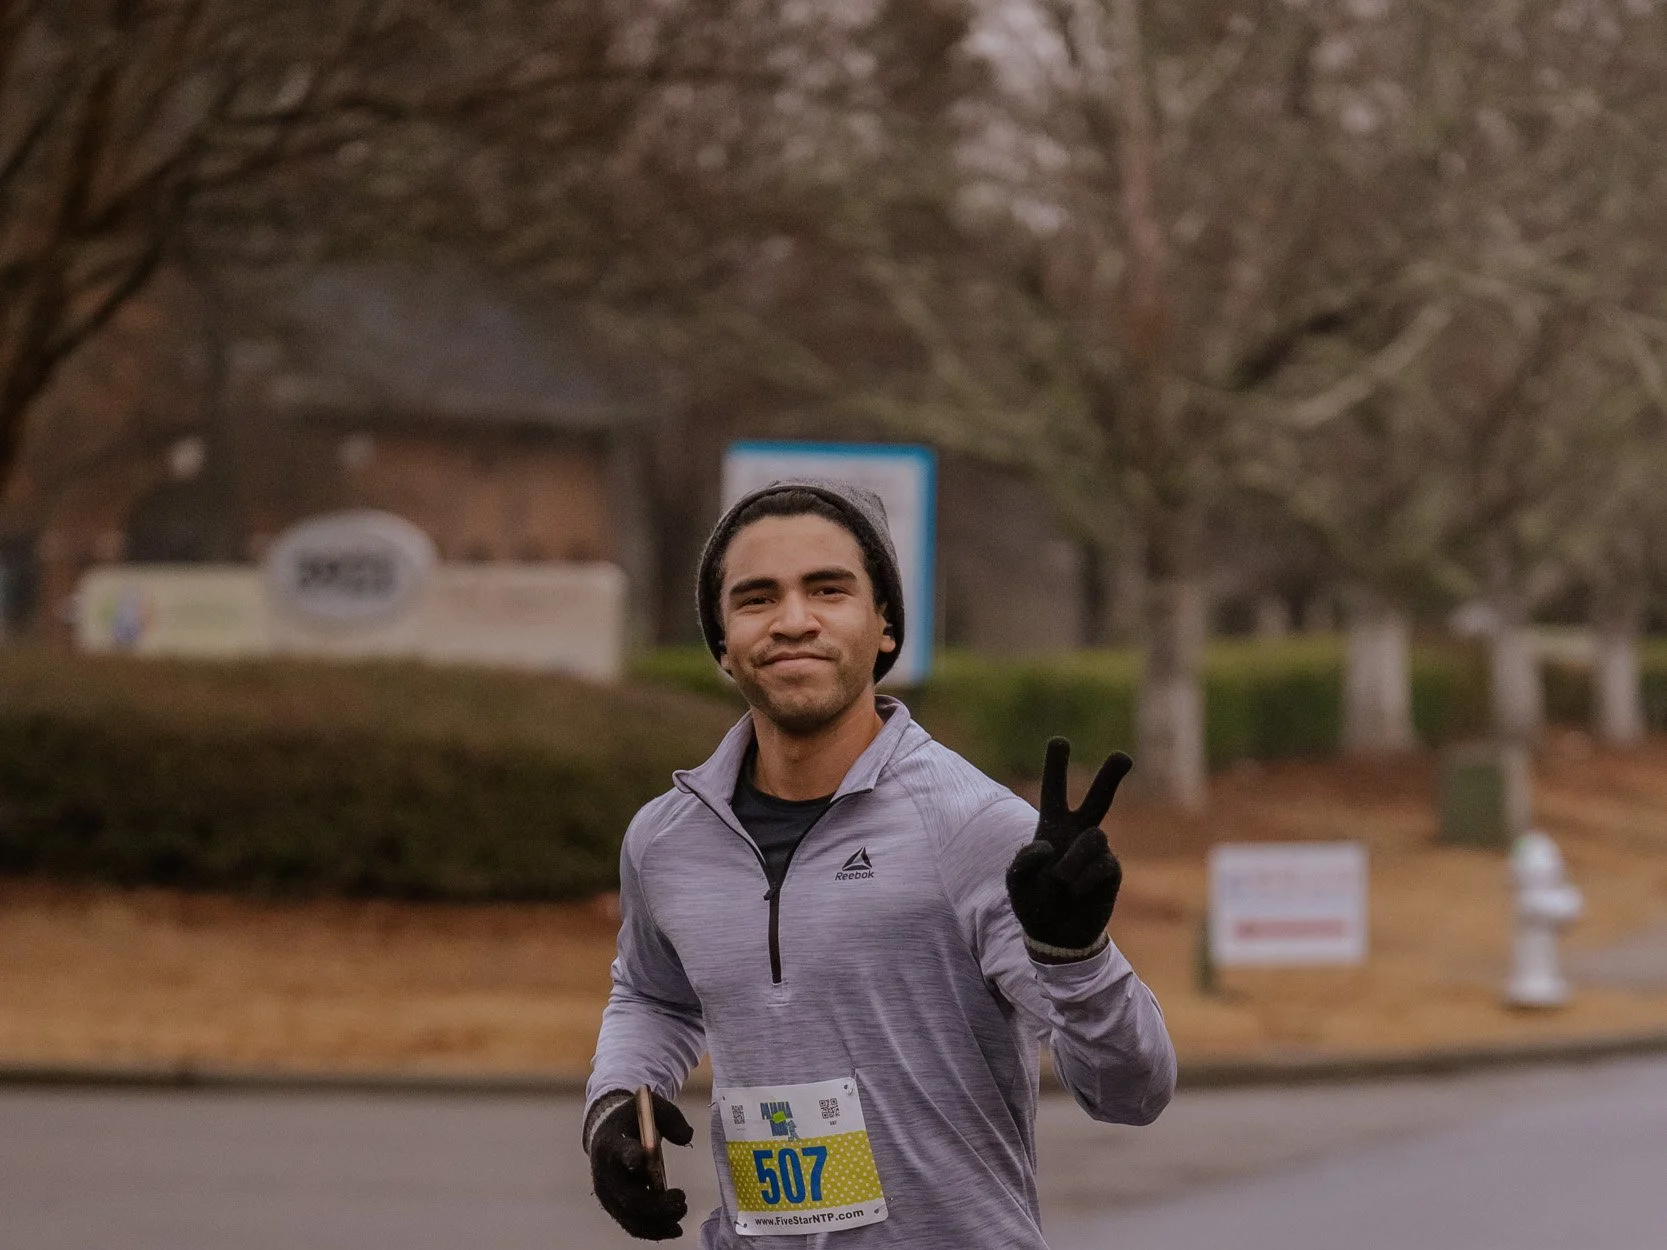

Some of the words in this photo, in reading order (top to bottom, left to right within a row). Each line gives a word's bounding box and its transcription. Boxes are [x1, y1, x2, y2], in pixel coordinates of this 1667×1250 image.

[834, 870, 875, 881] Reebok
[752, 1145, 828, 1205] 507
[754, 1209, 864, 1226] www.FiveStarNTP.com
